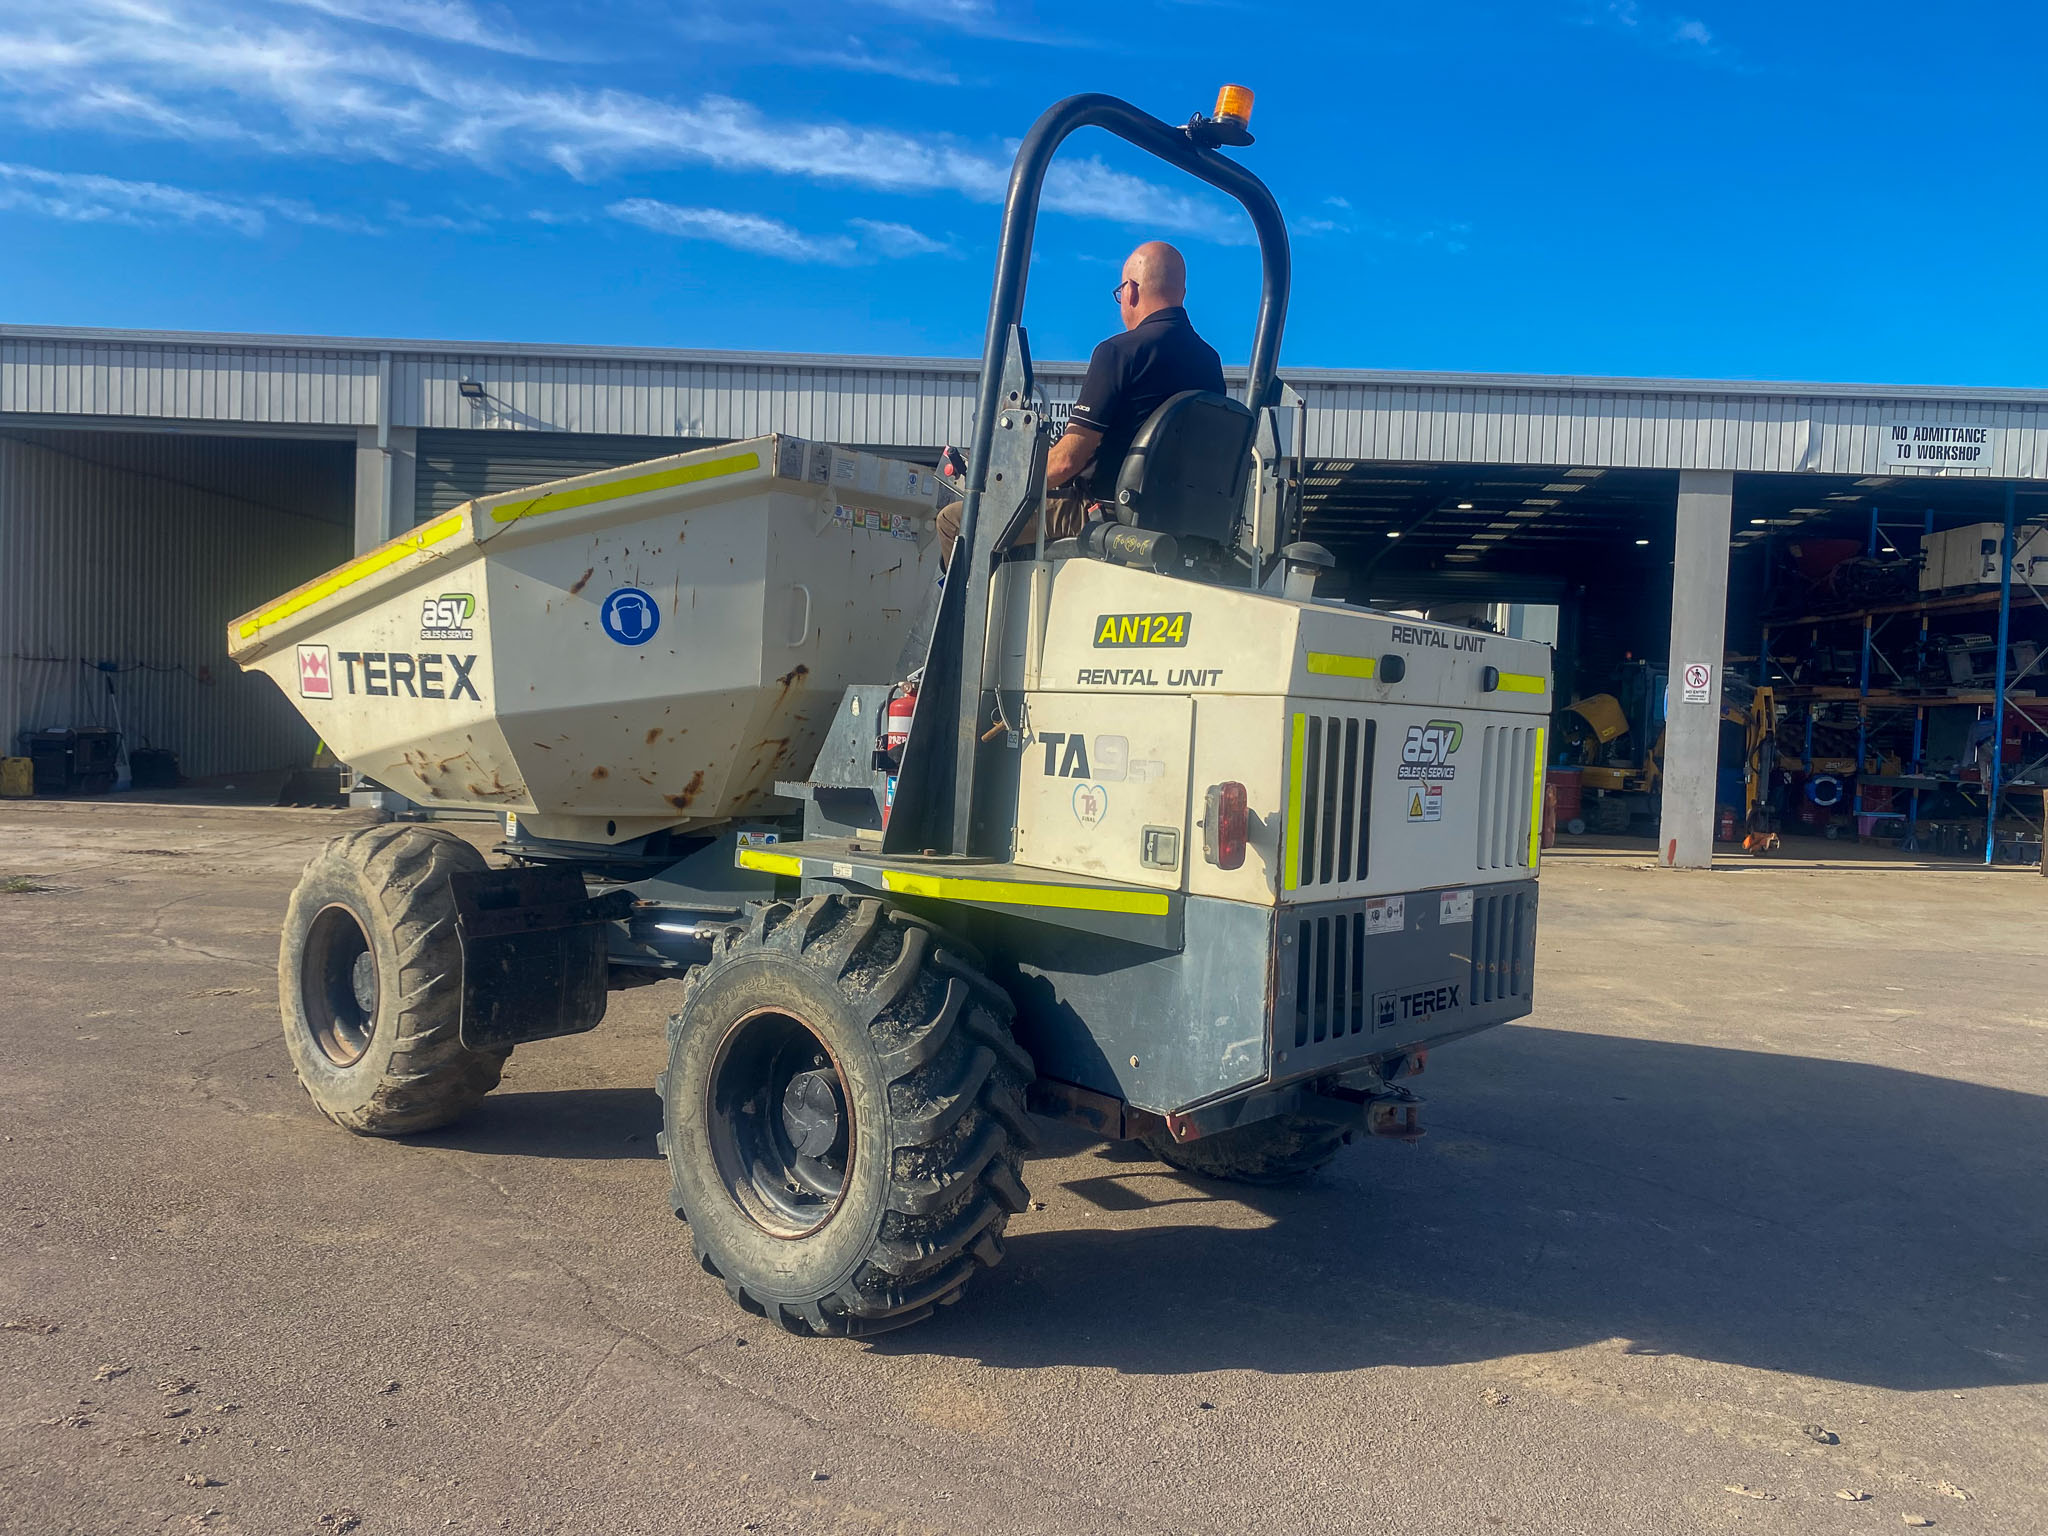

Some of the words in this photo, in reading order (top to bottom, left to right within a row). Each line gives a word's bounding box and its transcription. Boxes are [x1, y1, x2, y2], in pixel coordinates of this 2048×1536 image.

[1892, 426, 1907, 440] NO
[1913, 427, 1987, 443] ADMITTANCE
[1897, 444, 1911, 459] TO
[1918, 445, 1981, 461] WORKSHOP
[448, 630, 472, 639] SERVICE
[1098, 615, 1184, 643] AN124
[1392, 625, 1448, 648] RENTAL
[1454, 634, 1486, 653] UNIT
[337, 652, 481, 701] TEREX
[1077, 669, 1158, 686] RENTAL
[1167, 669, 1223, 687] UNIT
[1428, 767, 1455, 778] SERVICE
[1400, 984, 1459, 1018] TEREX
